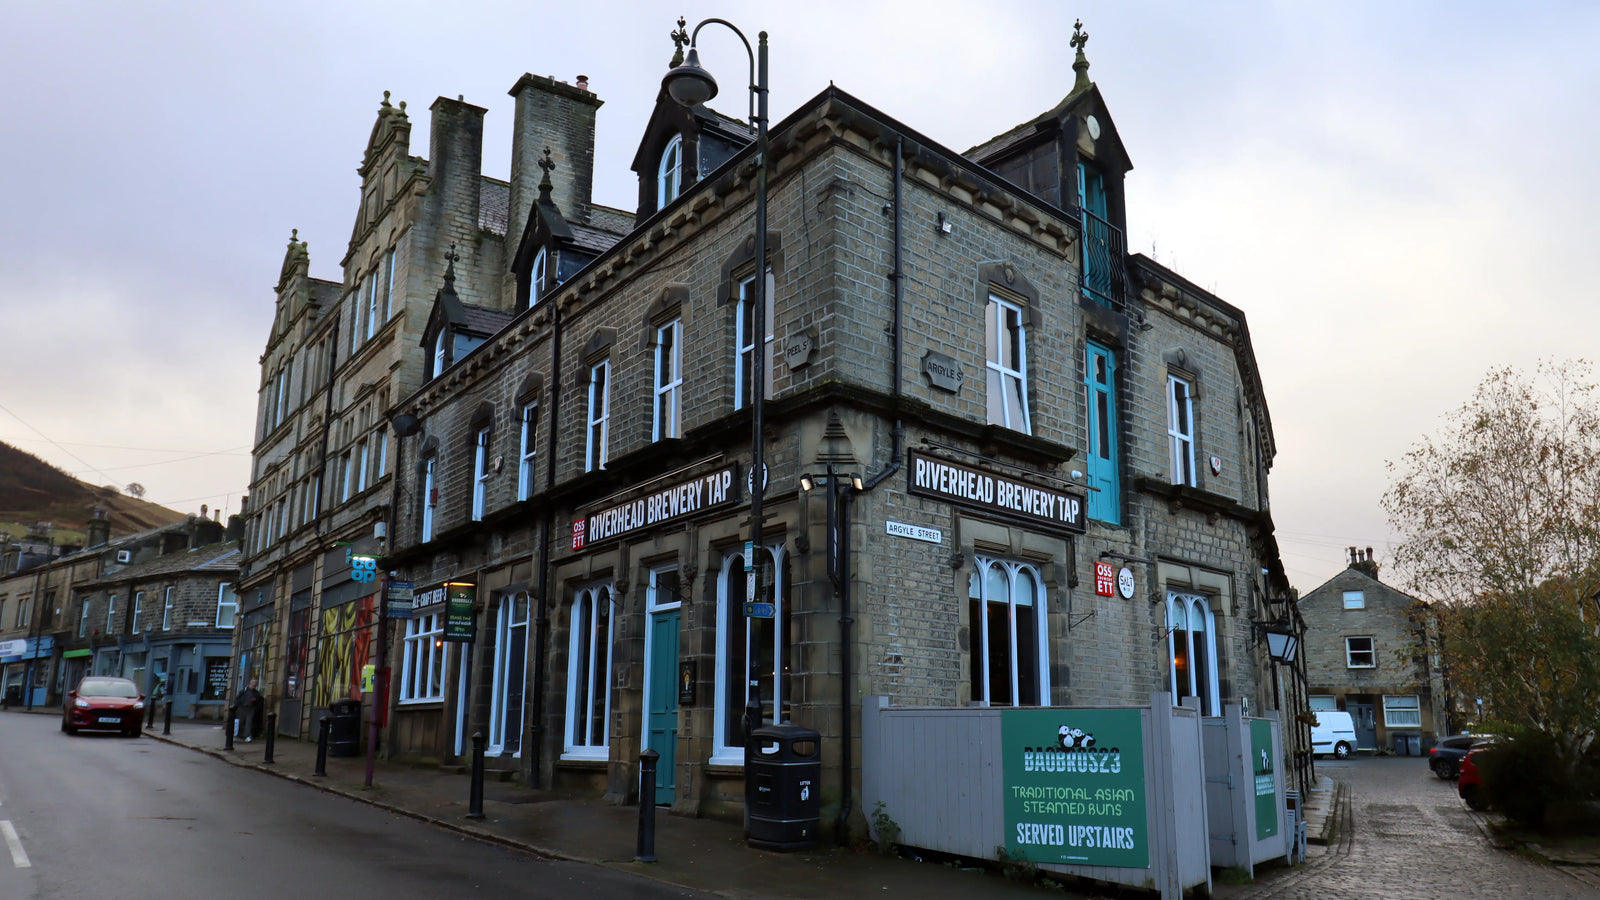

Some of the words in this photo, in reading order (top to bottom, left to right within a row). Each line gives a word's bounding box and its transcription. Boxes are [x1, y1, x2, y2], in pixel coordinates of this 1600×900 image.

[787, 343, 801, 358] PEEL
[927, 361, 955, 380] ARGYLE
[915, 458, 994, 504] RIVERHEAD
[997, 479, 1056, 519] BREWERY
[1057, 496, 1080, 524] TAP
[589, 499, 645, 543] RIVERHEAD
[647, 478, 704, 525] BREWERY
[706, 469, 732, 506] TAP
[573, 520, 585, 533] OSS
[889, 524, 914, 536] ARGYLE
[917, 529, 940, 541] STREET
[572, 534, 585, 549] ETT
[1097, 564, 1113, 578] OSS
[1097, 580, 1113, 595] ETT
[1119, 575, 1133, 588] SALT
[1024, 747, 1121, 773] BAOBROS23
[1012, 786, 1092, 801] TRADITIONAL
[1094, 788, 1135, 802] ASIAN
[1024, 801, 1085, 815] STEAMED
[1088, 803, 1122, 816] BUNS
[1016, 822, 1064, 846] SERVED
[1068, 824, 1134, 849] UPSTAIRS
